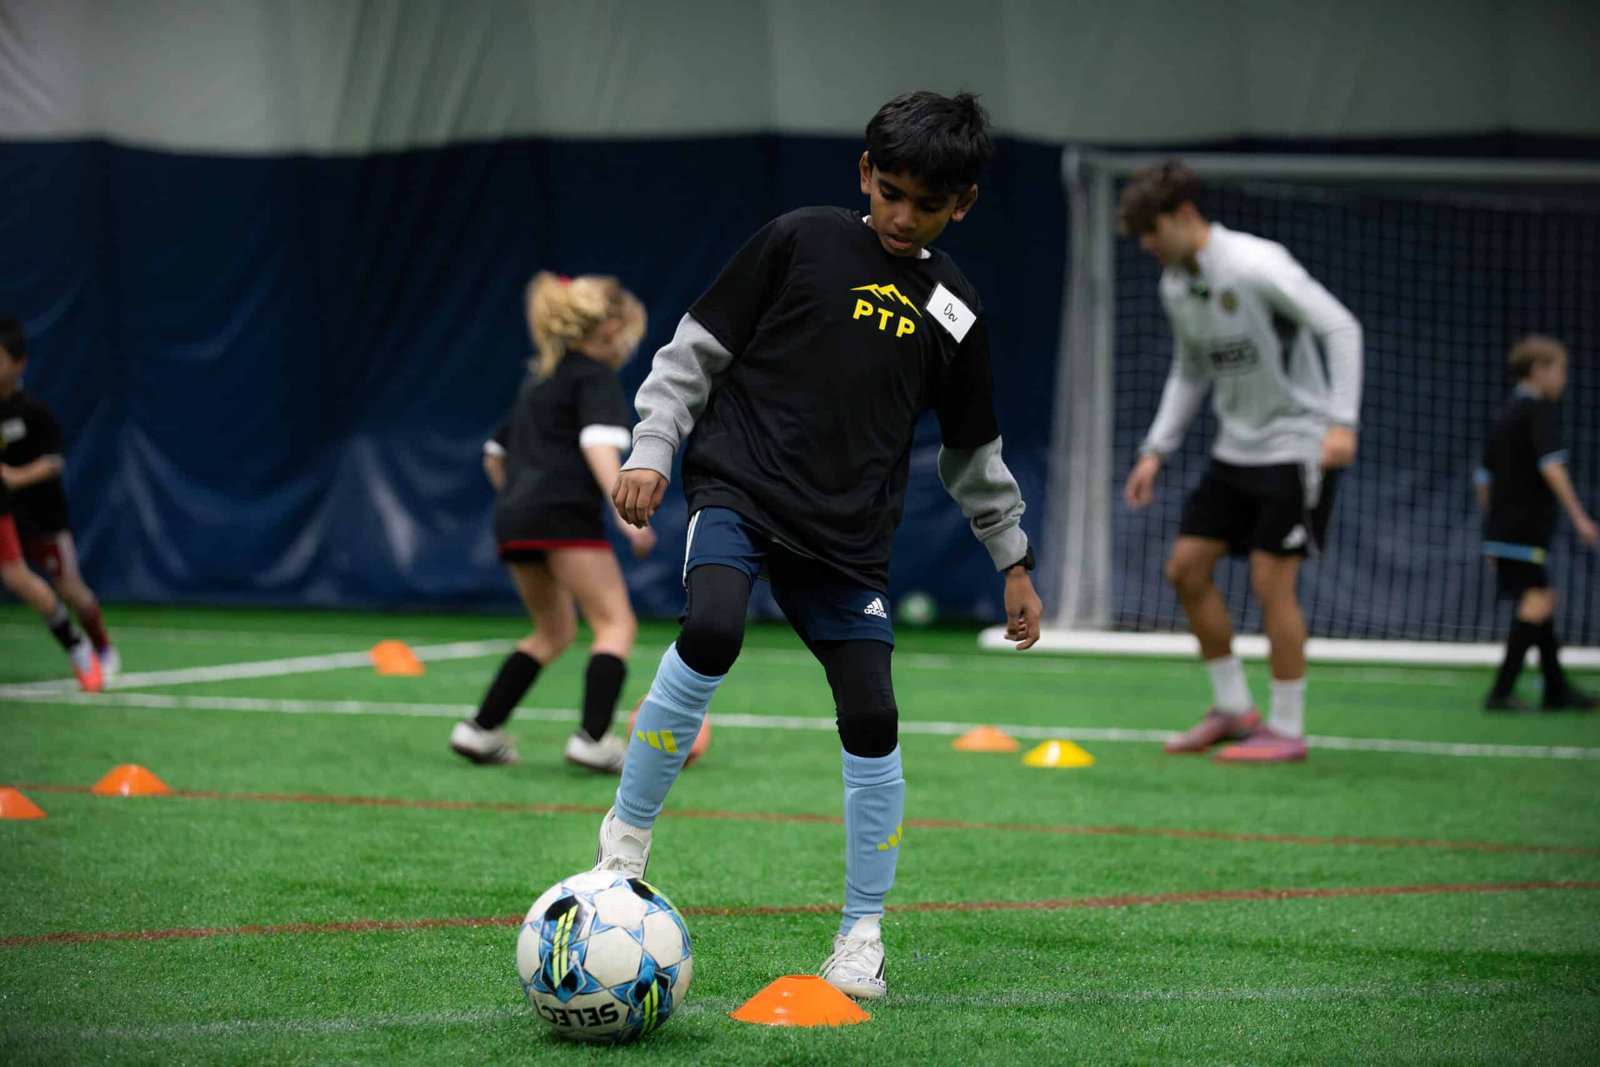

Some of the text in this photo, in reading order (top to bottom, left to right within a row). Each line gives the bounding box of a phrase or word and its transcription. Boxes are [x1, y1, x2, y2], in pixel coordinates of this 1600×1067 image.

[852, 298, 916, 338] PTP
[943, 302, 958, 322] Dev
[863, 608, 888, 619] adidas
